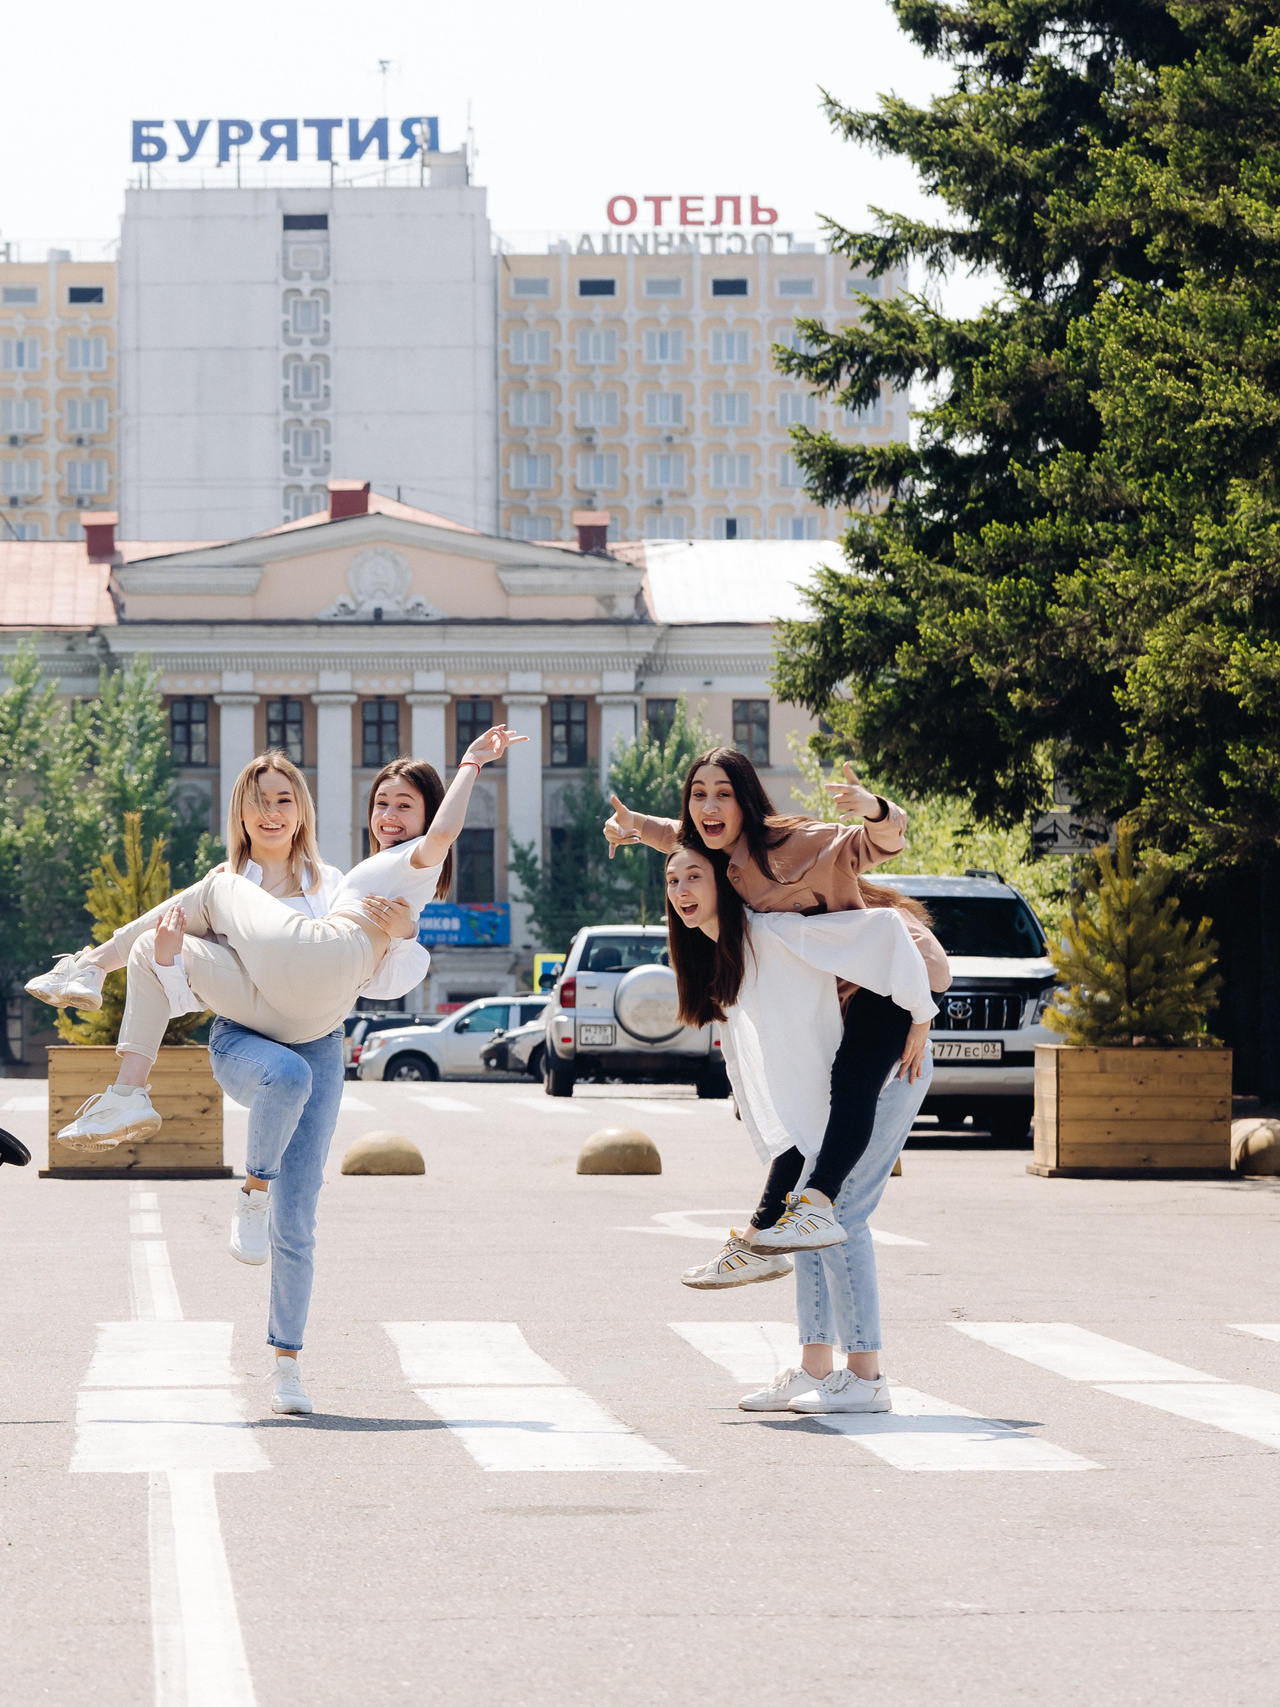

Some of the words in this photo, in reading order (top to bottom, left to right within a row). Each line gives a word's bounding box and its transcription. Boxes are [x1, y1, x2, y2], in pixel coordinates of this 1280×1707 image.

[131, 117, 439, 163] БУРЯТИЯ
[606, 195, 779, 226] ОТЕЛЬ
[983, 1043, 996, 1054] 03
